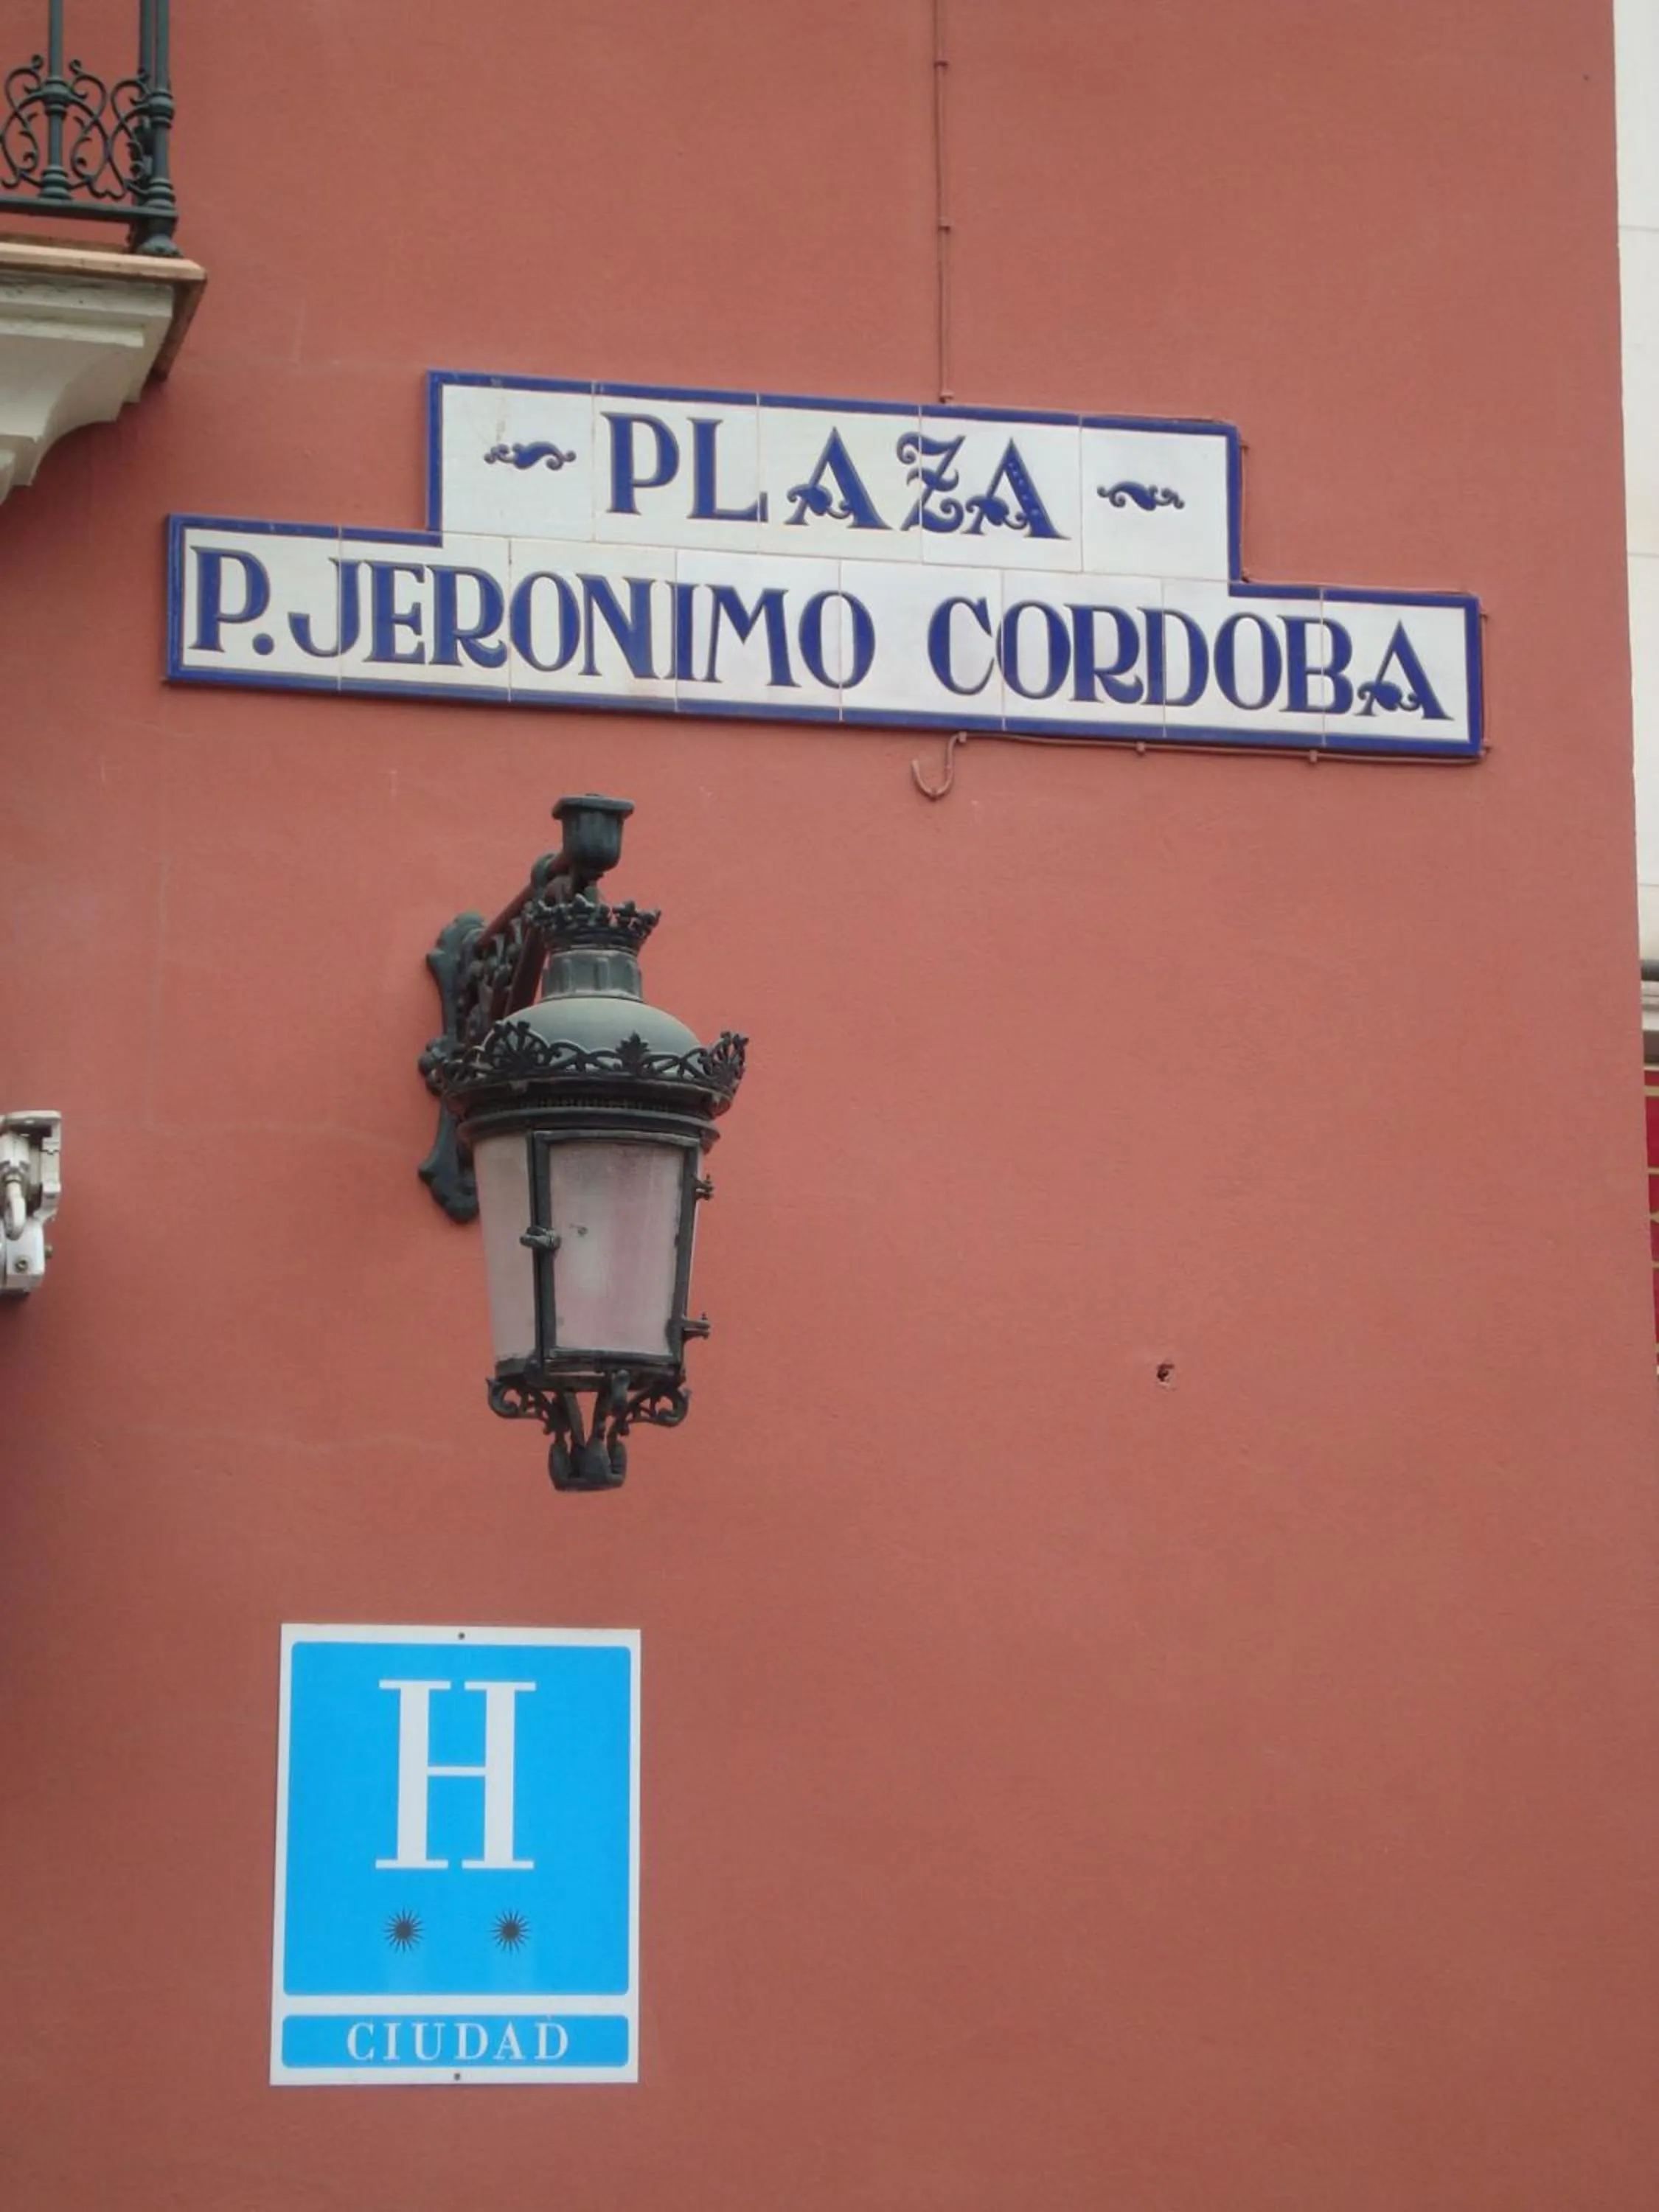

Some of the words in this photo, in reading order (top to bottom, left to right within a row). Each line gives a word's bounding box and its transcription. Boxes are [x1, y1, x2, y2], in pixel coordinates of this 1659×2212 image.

[601, 411, 1071, 540] PLAZA
[927, 596, 1454, 720] CORDOBA
[375, 1679, 536, 1869] H
[347, 2021, 568, 2062] CIUDAD
